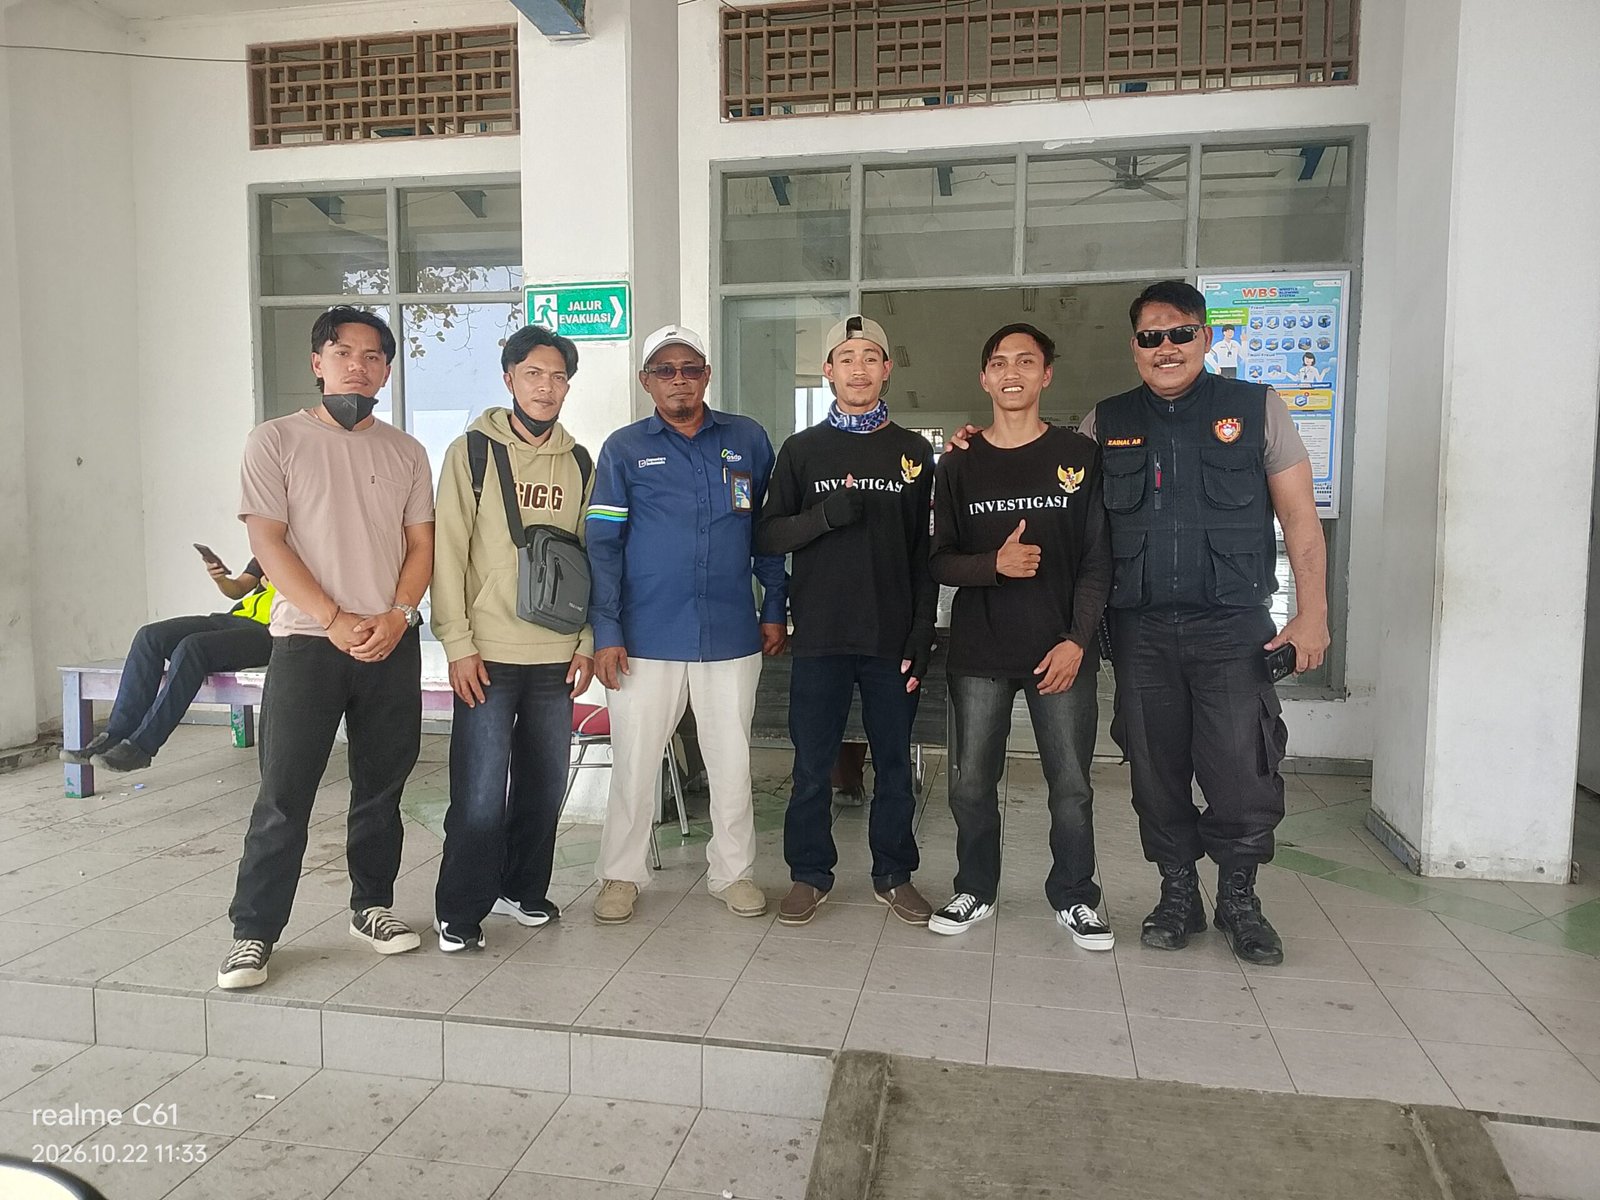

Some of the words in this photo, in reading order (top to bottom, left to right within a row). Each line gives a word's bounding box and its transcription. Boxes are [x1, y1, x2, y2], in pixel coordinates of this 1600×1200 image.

[1242, 287, 1278, 298] WBS
[567, 300, 602, 311] JALUR
[559, 312, 611, 324] EVAKUASI
[969, 496, 1068, 515] INVESTIGASI
